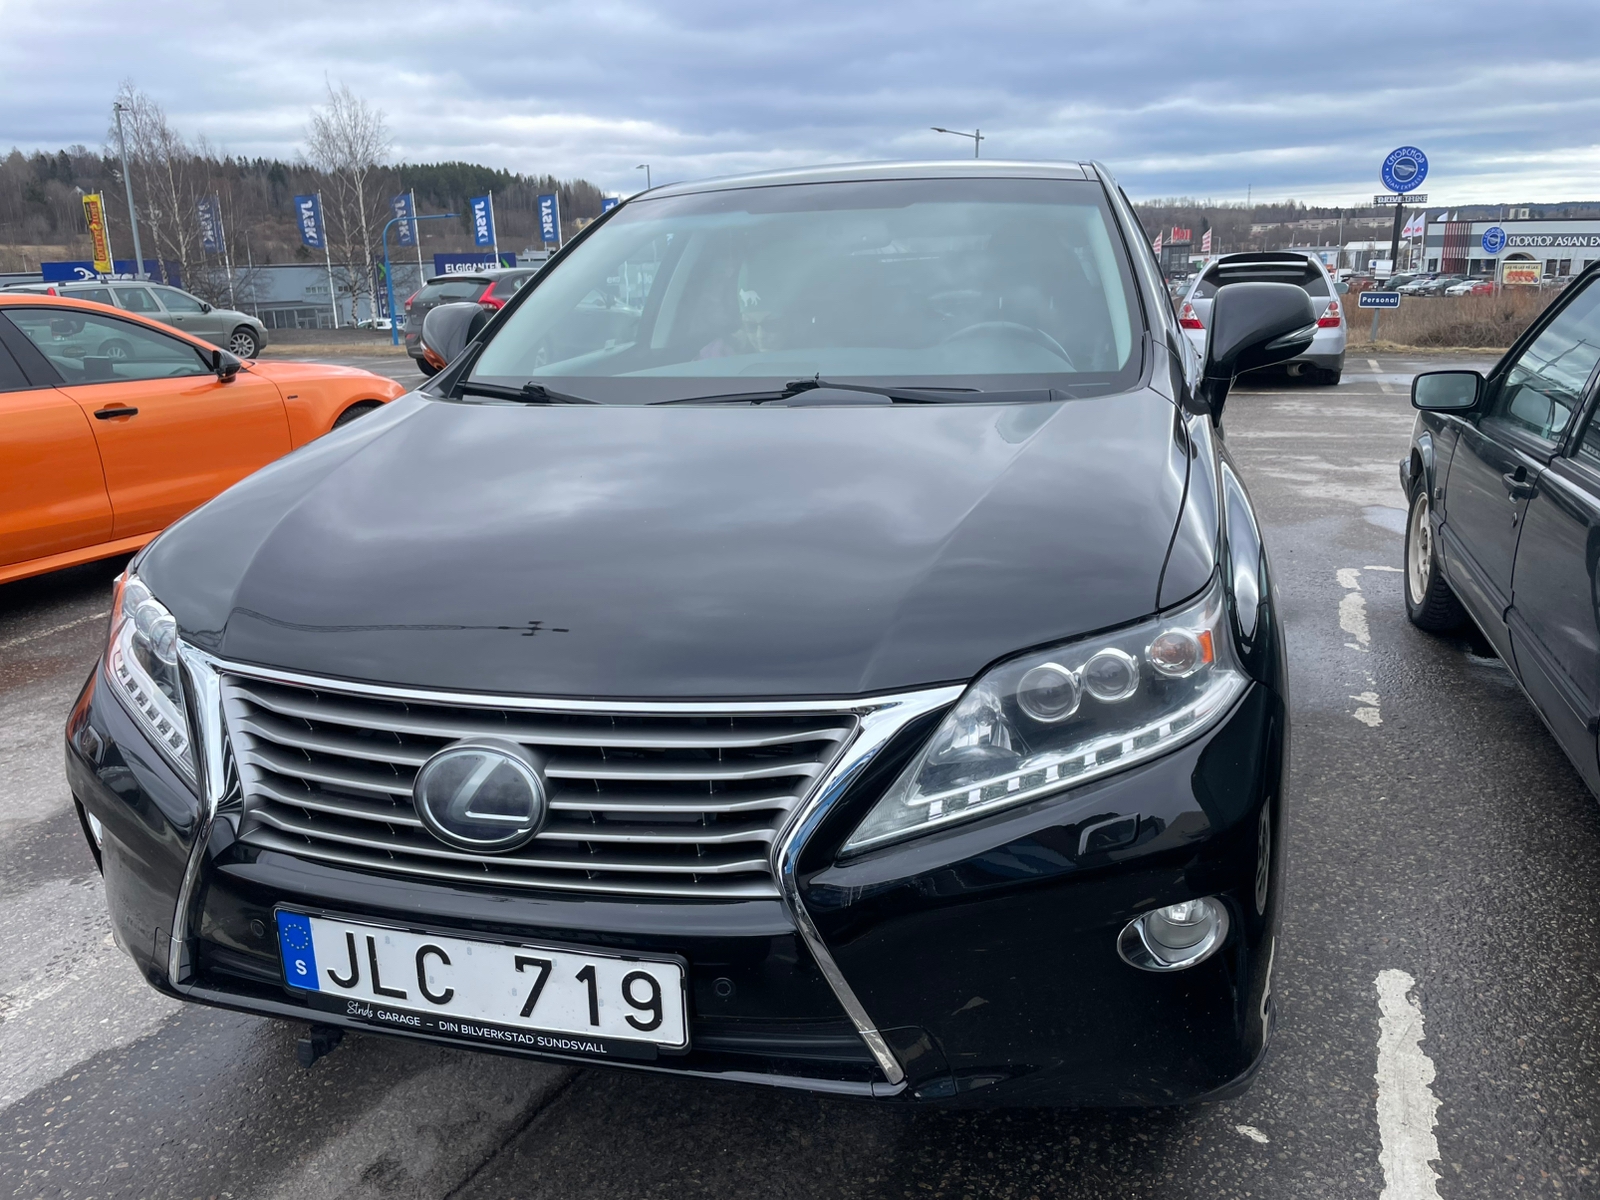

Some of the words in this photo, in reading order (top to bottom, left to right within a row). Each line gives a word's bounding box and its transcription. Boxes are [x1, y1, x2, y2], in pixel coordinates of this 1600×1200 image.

[1386, 148, 1425, 166] CHOPCHOP
[1385, 175, 1400, 190] ASIAN
[1401, 175, 1424, 190] EXPRESS
[1508, 235, 1553, 246] CHOPCHOP
[1554, 236, 1588, 247] ASIAN
[295, 959, 308, 976] S
[326, 930, 455, 1006] JLC
[514, 955, 663, 1032] 719
[377, 1010, 421, 1027] GARAGE
[438, 1021, 459, 1032] DIN
[461, 1024, 534, 1044] BILVERKSTAD
[537, 1036, 607, 1053] SUNDSVALL
